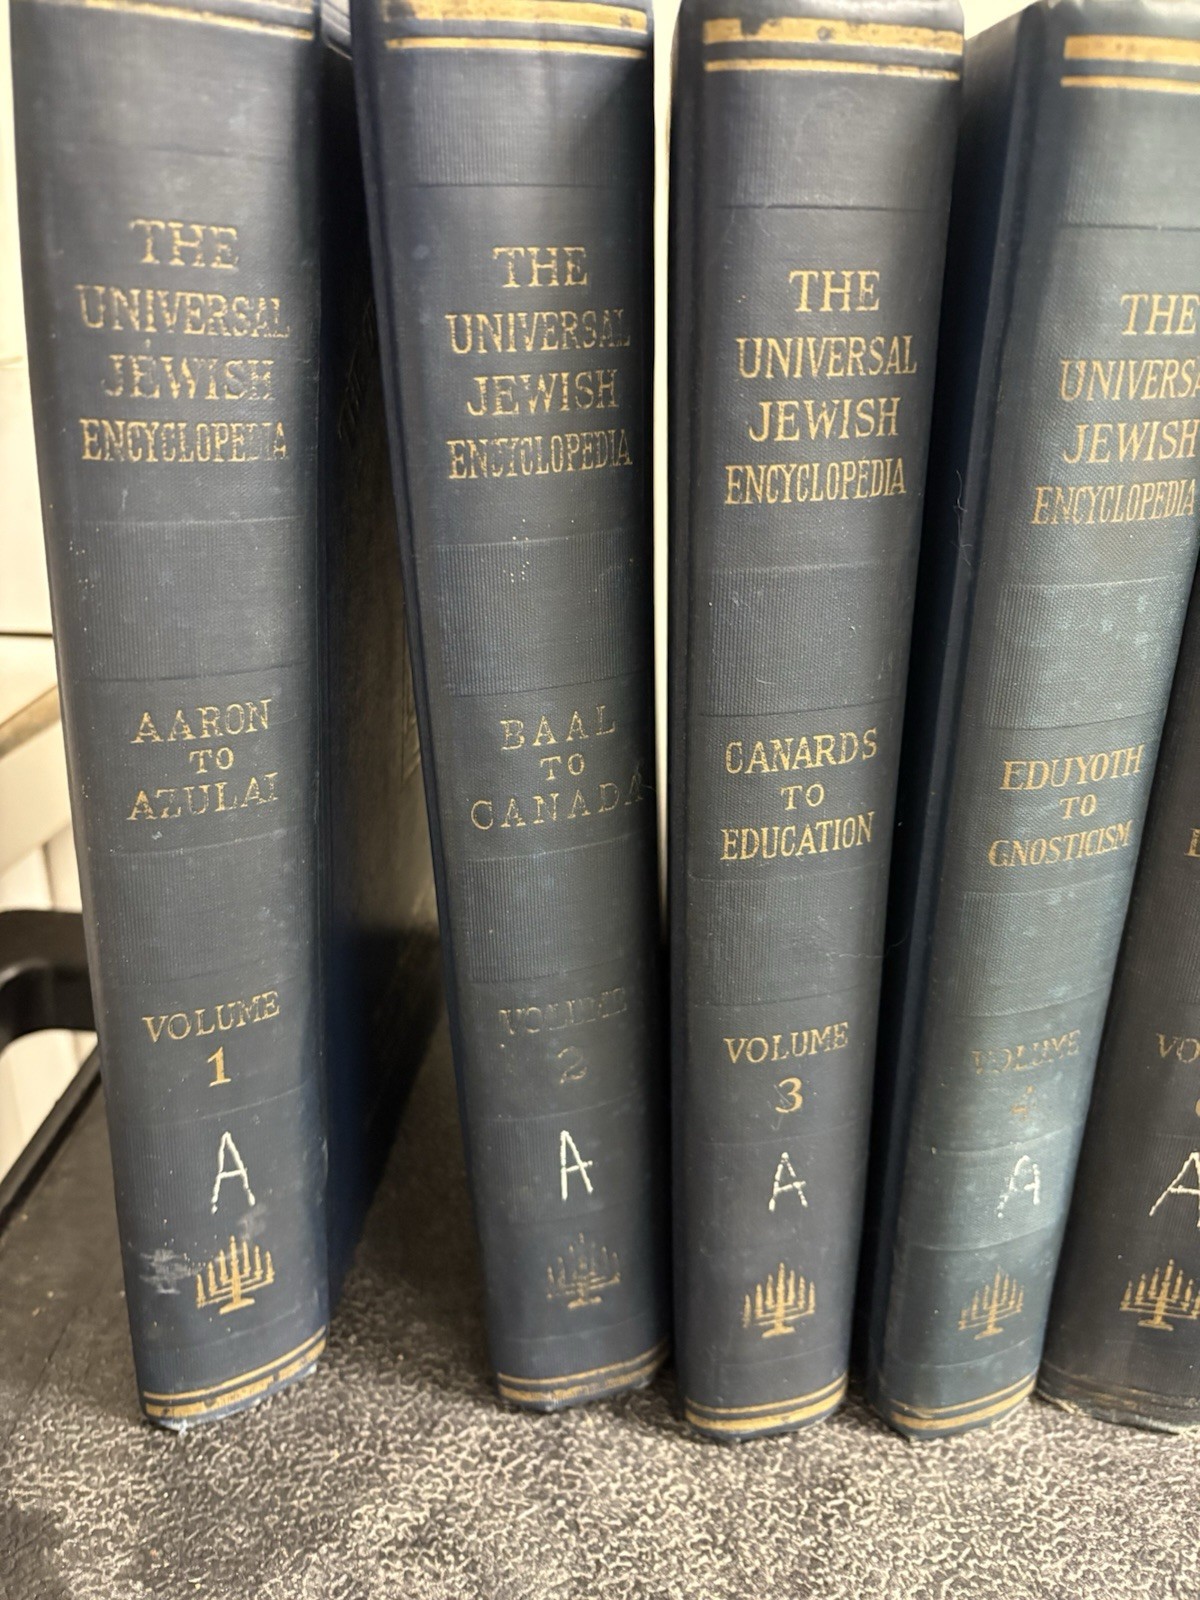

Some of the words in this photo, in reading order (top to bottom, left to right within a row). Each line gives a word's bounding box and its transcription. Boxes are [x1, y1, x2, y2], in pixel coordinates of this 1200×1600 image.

[129, 219, 239, 269] THE
[492, 246, 589, 288] THE
[74, 284, 291, 338] UNIVERSAL
[789, 270, 881, 313] THE
[1120, 293, 1200, 336] THE
[444, 308, 631, 354] UNIVERSAL
[101, 354, 276, 401] JEWISH
[736, 335, 917, 379] UNIVERSAL
[466, 369, 619, 416] JEWISH
[749, 397, 901, 442] JEWISH
[1063, 418, 1200, 464] JEWISH
[446, 429, 633, 479] ENCYCLOPEDIA
[724, 456, 907, 505] ENCYCLOPEDIA
[1031, 479, 1197, 525] ENCYCLOPEDIA
[130, 699, 272, 744] AARON
[500, 705, 616, 750] BAAL
[189, 747, 234, 774] TO
[540, 753, 585, 780] TO
[725, 727, 877, 774] CANARDS
[1000, 743, 1145, 790] EDUYOTH
[126, 772, 278, 820] AZULAI
[471, 771, 644, 830] CANADA
[781, 783, 825, 811] TO
[1059, 794, 1097, 820] TO
[720, 811, 875, 860] EDUCATION
[987, 819, 1133, 867] GNOSTICISM
[142, 990, 280, 1043] VOLUME
[558, 1046, 588, 1084] 2
[723, 1021, 849, 1064] VOLUME
[207, 1046, 231, 1088] 1
[775, 1077, 803, 1114] 3
[211, 1131, 255, 1214] A
[560, 1130, 593, 1201] A
[768, 1152, 808, 1212] A
[996, 1155, 1041, 1218] A
[1149, 1152, 1200, 1228] A
